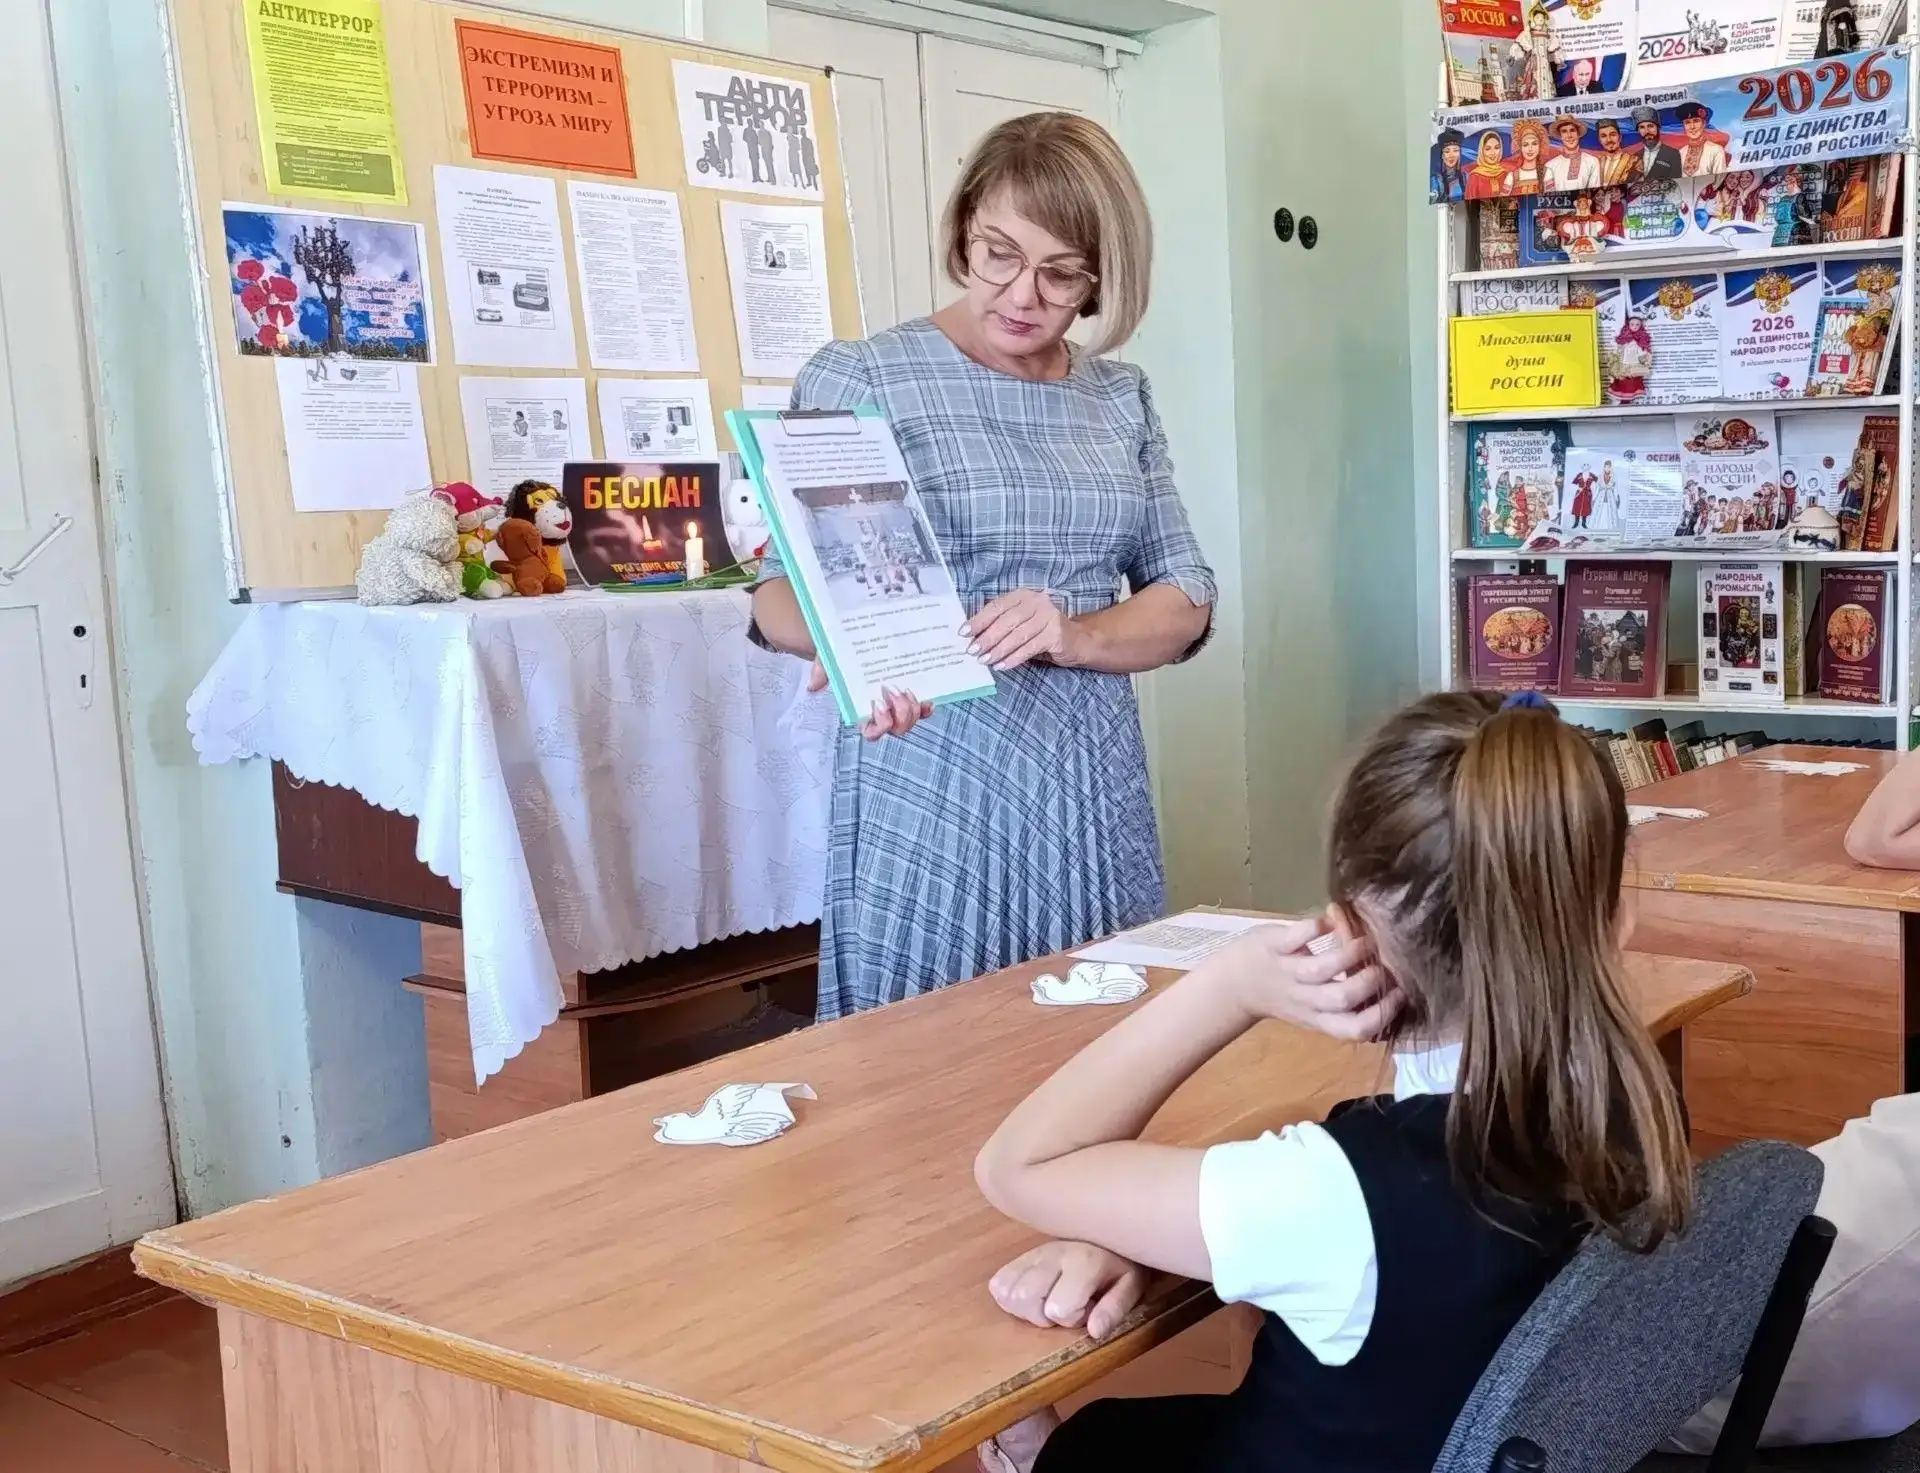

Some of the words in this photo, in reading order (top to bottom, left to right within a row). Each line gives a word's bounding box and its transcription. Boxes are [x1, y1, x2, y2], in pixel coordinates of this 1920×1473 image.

[259, 1, 373, 34] АНТИТЕРРОР
[1460, 8, 1506, 27] РОССИЯ
[1731, 22, 1748, 30] ГОД
[1731, 26, 1776, 38] ЕДИНСТВА
[1730, 34, 1772, 46] НАРОДОВ
[1638, 37, 1685, 60] 2026
[1729, 43, 1767, 53] РОССИИ
[465, 45, 596, 81] ЭКСТРЕМИЗМ
[601, 67, 614, 83] И
[482, 75, 594, 106] ТЕРРОРИЗМ
[727, 76, 806, 109] АНТИ
[1738, 51, 1892, 122] 2026
[696, 91, 808, 134] ТЕРРОР
[1446, 112, 1491, 126] единстве
[1500, 109, 1526, 121] наша
[1527, 107, 1554, 118] сила,
[1556, 107, 1562, 116] в
[1564, 102, 1606, 116] сердцах
[1616, 97, 1642, 110] одна
[1644, 89, 1688, 104] Россия!
[483, 103, 557, 129] УГРОЗА
[560, 116, 613, 136] МИРУ
[1742, 124, 1780, 147] ГОД
[1784, 109, 1888, 142] ЕДИНСТВА
[1739, 141, 1812, 164] НАРОДОВ
[1816, 131, 1890, 153] РОССИИ!
[1537, 196, 1572, 208] РУСЬ
[1473, 280, 1560, 294] ИСТОРИЯ
[1752, 315, 1795, 332] 2026
[1478, 333, 1572, 347] Многоликая
[1737, 336, 1757, 345] ГОД
[1759, 331, 1810, 343] ЕДИНСТВА
[1730, 346, 1776, 356] НАРОДОВ
[1506, 356, 1545, 370] душа
[1490, 374, 1564, 390] РОССИИ
[1492, 440, 1549, 448] ПРАЗДНИКИ
[1499, 448, 1543, 456] НАРОДОВ
[1705, 463, 1754, 474] НАРОДЫ
[1704, 474, 1756, 485] РОССИИ
[583, 476, 701, 510] БЕСЛАН
[1715, 573, 1763, 582] НАРОДНЫЕ
[1714, 583, 1765, 592] ПРОМЫСЛЫ
